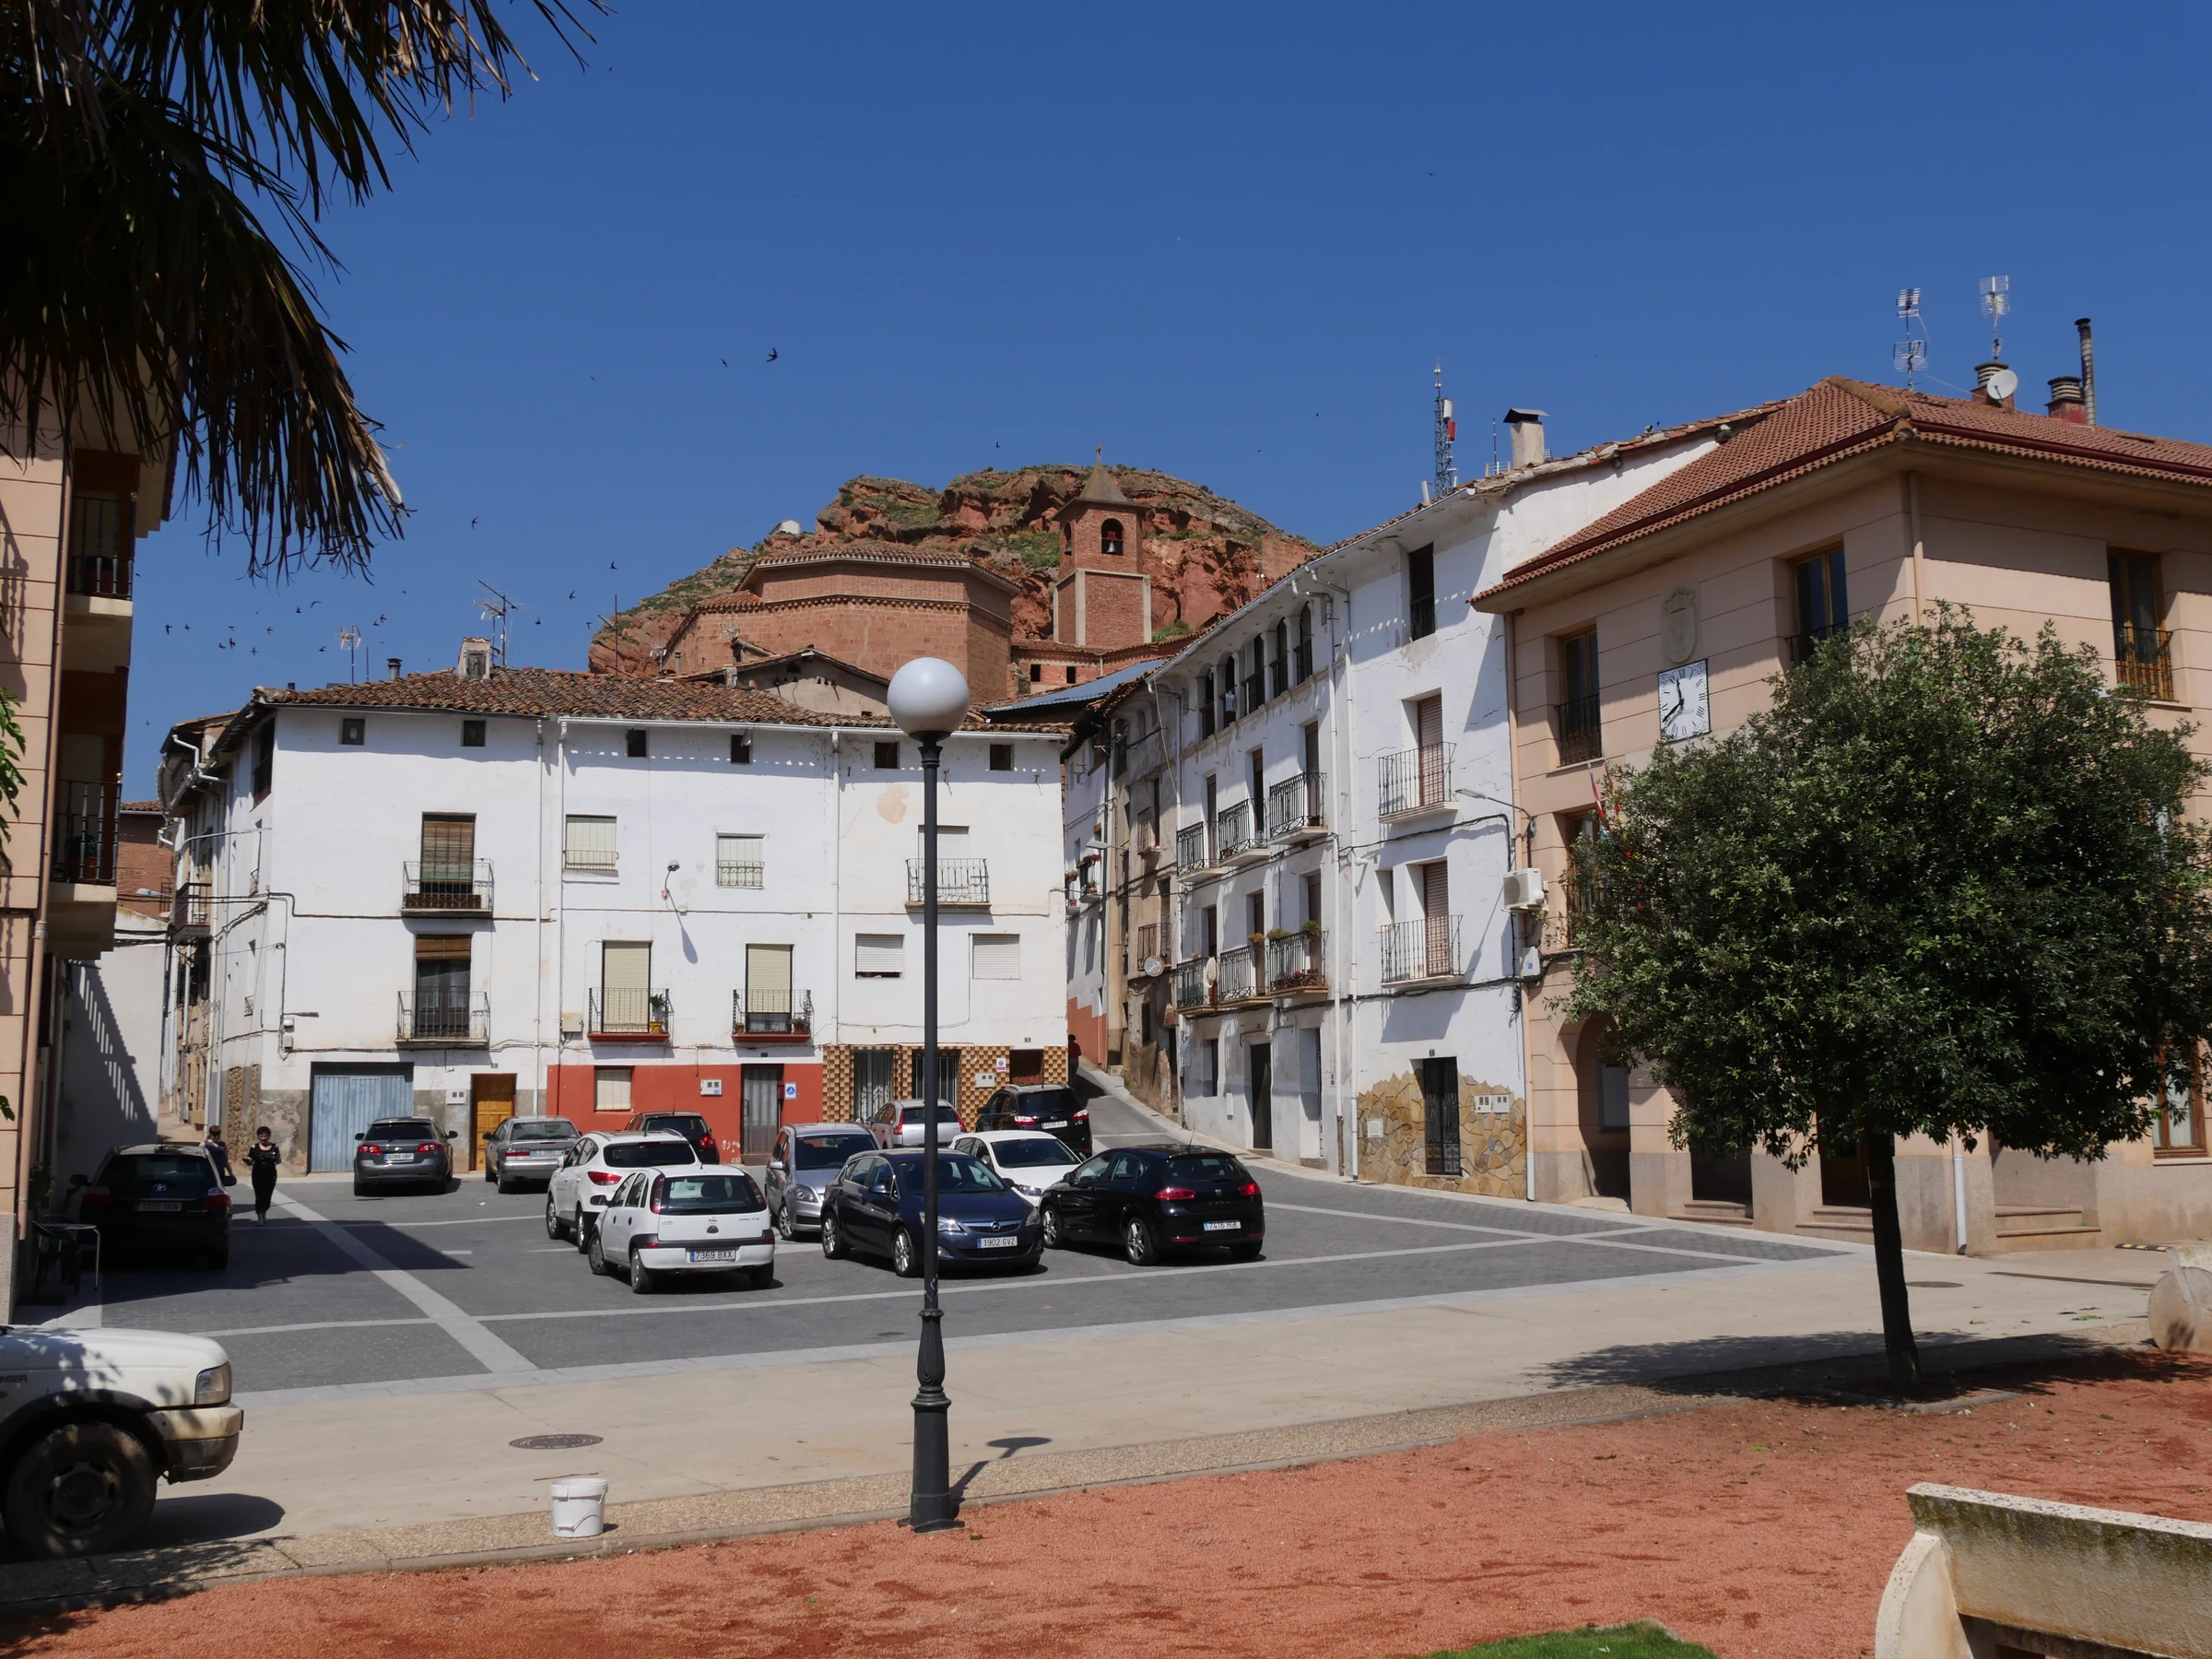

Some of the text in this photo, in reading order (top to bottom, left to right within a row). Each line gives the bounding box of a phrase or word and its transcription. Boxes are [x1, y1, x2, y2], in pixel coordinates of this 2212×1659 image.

[983, 1237, 1016, 1247] 1902 GVZ
[696, 1250, 733, 1260] 7369 BXX
